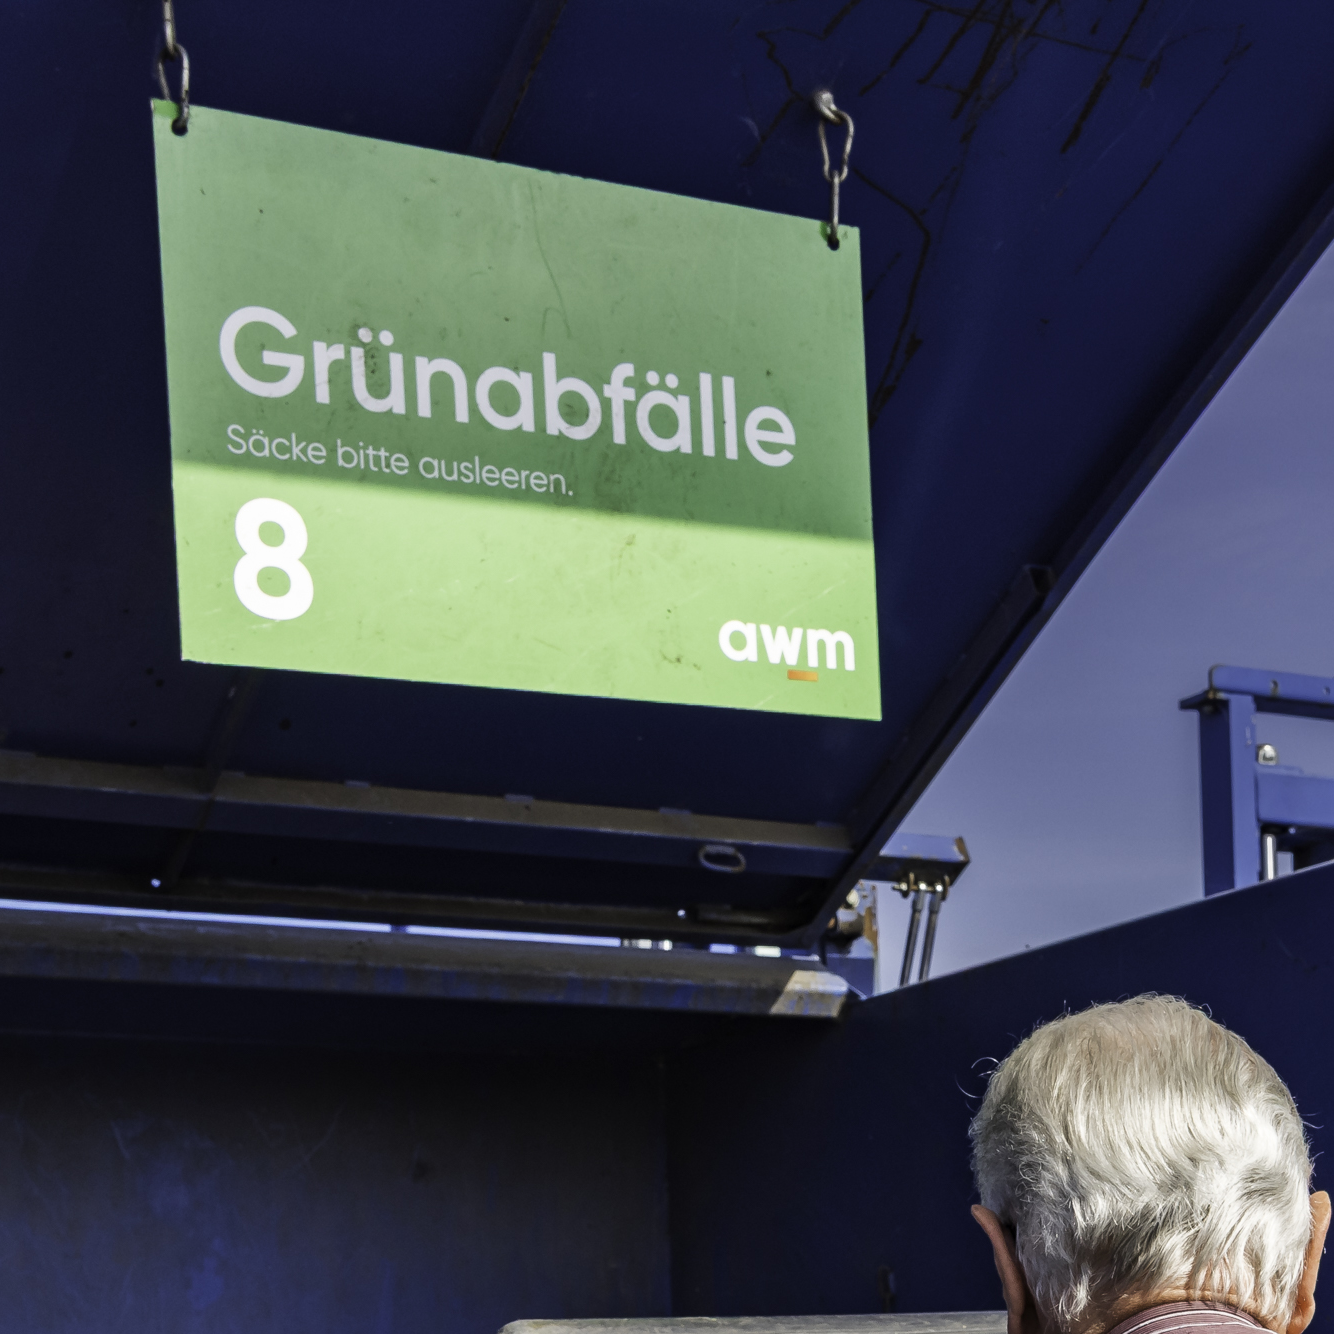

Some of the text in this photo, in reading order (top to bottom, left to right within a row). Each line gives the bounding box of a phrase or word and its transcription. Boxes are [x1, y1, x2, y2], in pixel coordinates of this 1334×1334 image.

[218, 305, 796, 468] Grünabfälle
[227, 424, 574, 497] Säcke bitte ausleeren.
[234, 497, 314, 621] 8
[718, 619, 855, 671] awm
